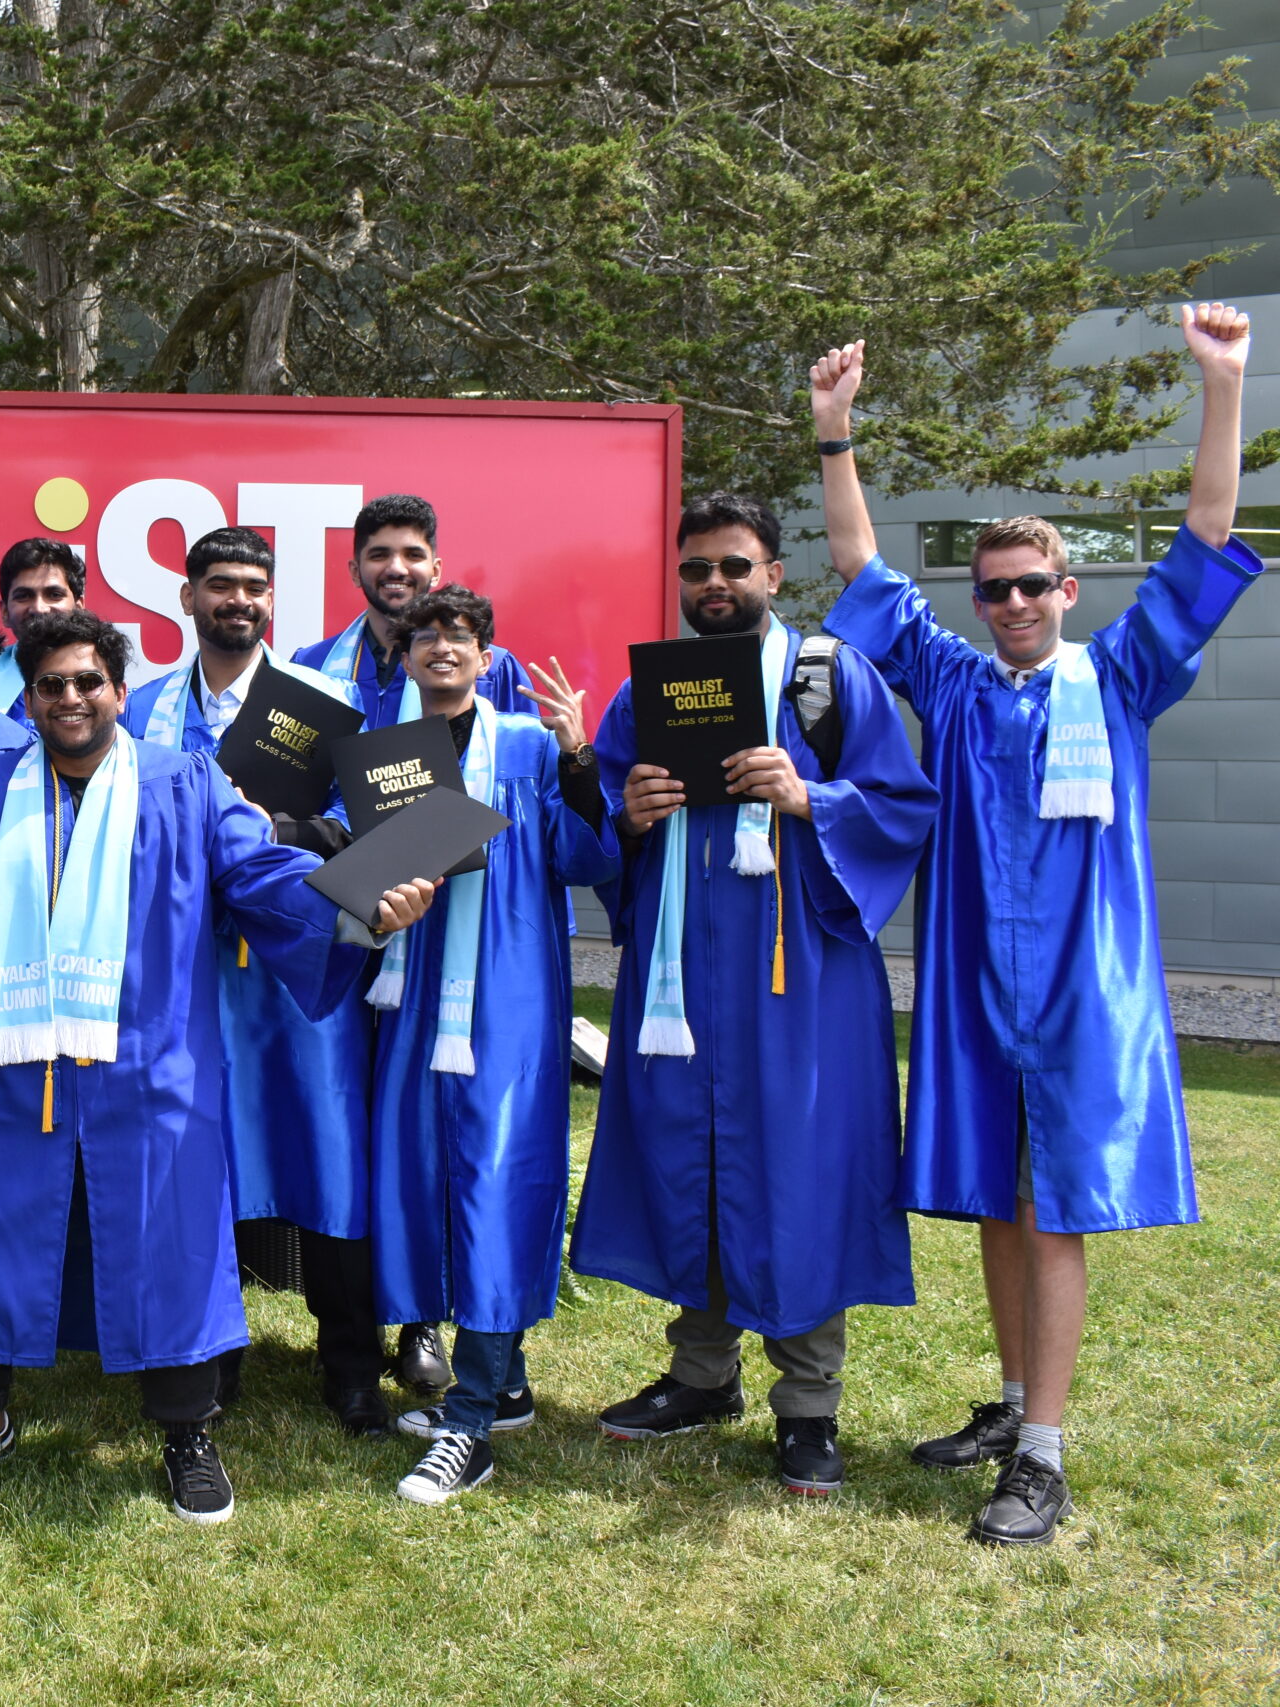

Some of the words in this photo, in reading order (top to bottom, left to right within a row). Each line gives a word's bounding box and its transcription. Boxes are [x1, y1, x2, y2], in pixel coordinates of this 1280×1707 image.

[663, 678, 724, 697] LOYALiST
[674, 693, 734, 710] COLLEGE
[267, 708, 320, 742] LOYALiST
[666, 717, 696, 726] CLASS
[697, 716, 711, 724] OF
[712, 714, 735, 723] 2024
[255, 739, 280, 756] CLASS
[365, 758, 422, 783] LOYALiST
[380, 770, 435, 795] COLLEGE
[375, 799, 403, 811] CLASS
[404, 795, 416, 804] OF
